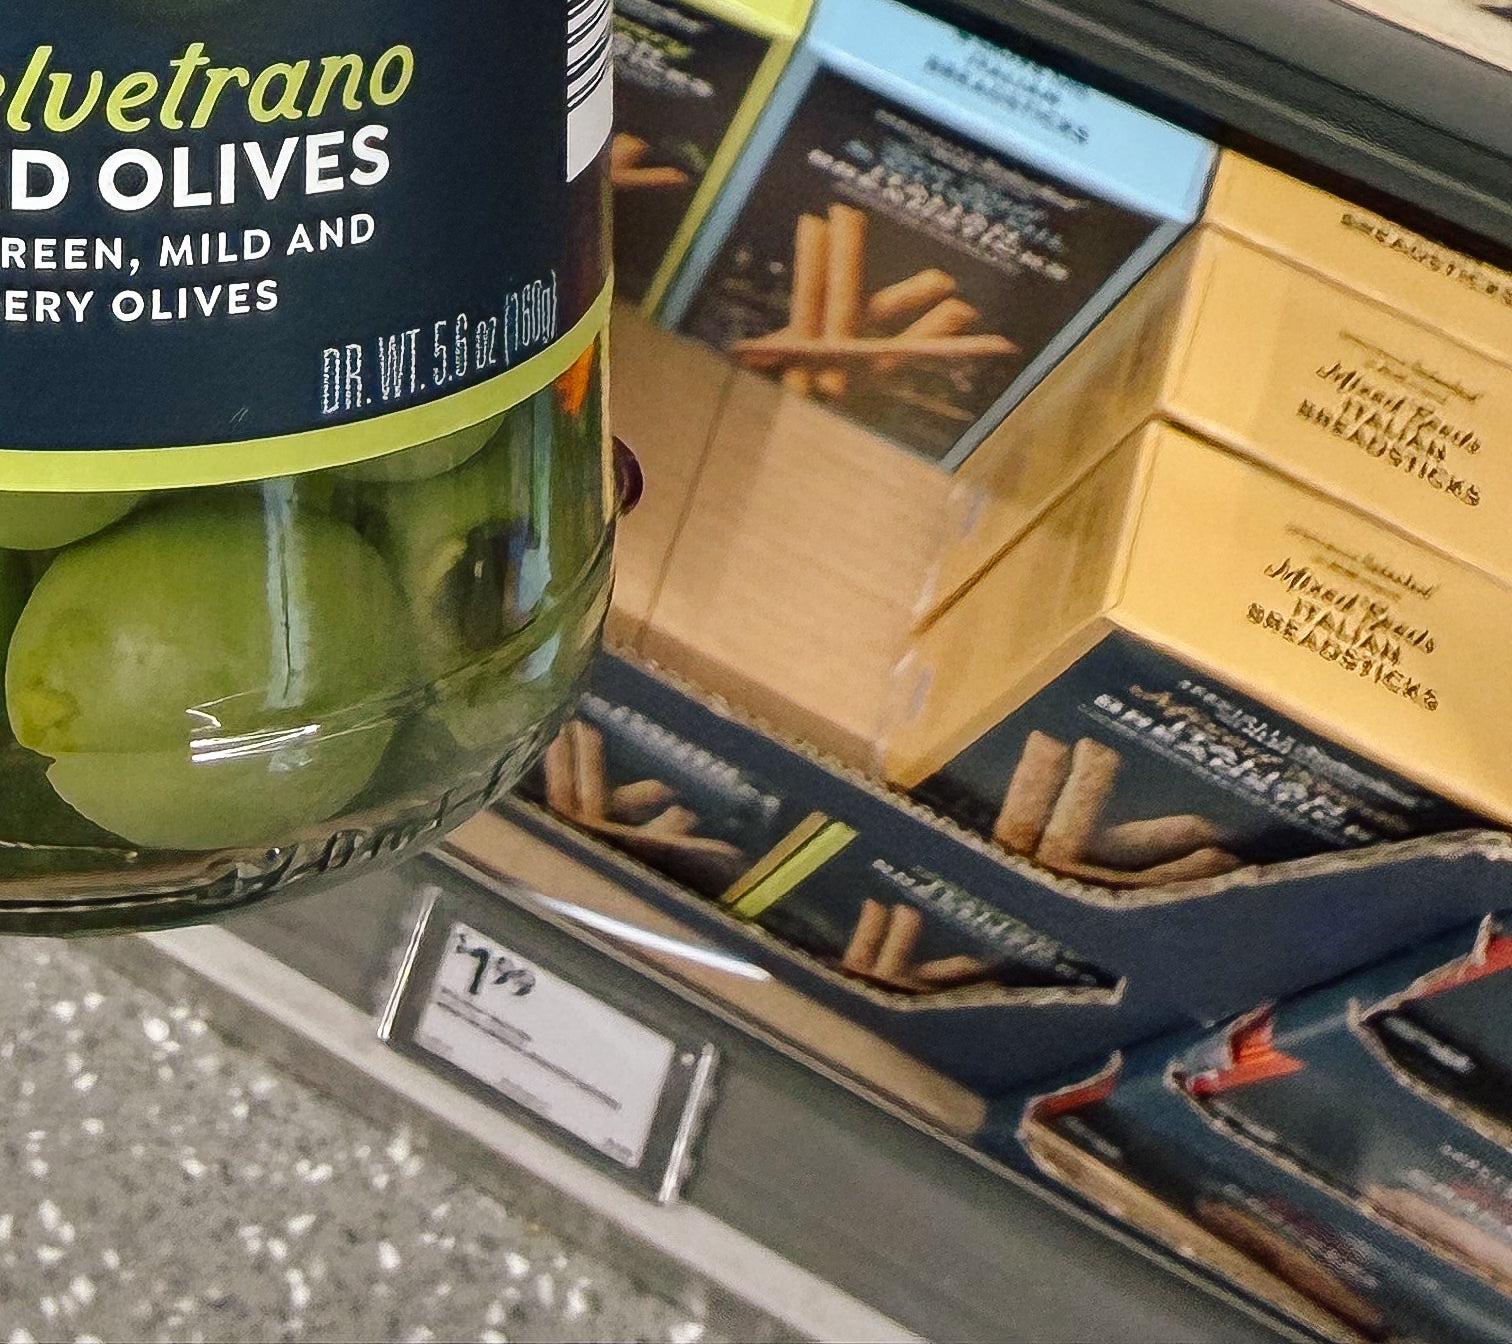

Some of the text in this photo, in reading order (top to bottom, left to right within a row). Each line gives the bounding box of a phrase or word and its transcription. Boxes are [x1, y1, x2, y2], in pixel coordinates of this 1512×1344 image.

[97, 123, 391, 212] OLIVES
[159, 226, 271, 268] MILD
[286, 212, 377, 258] AND
[110, 278, 280, 323] OLIVES
[321, 342, 373, 415] DR.
[377, 326, 427, 402] WT.
[432, 312, 469, 387] 5.6
[476, 315, 497, 370] oz
[1296, 398, 1482, 507] BREADSTICKS
[1245, 601, 1439, 712] BREADSTICKS
